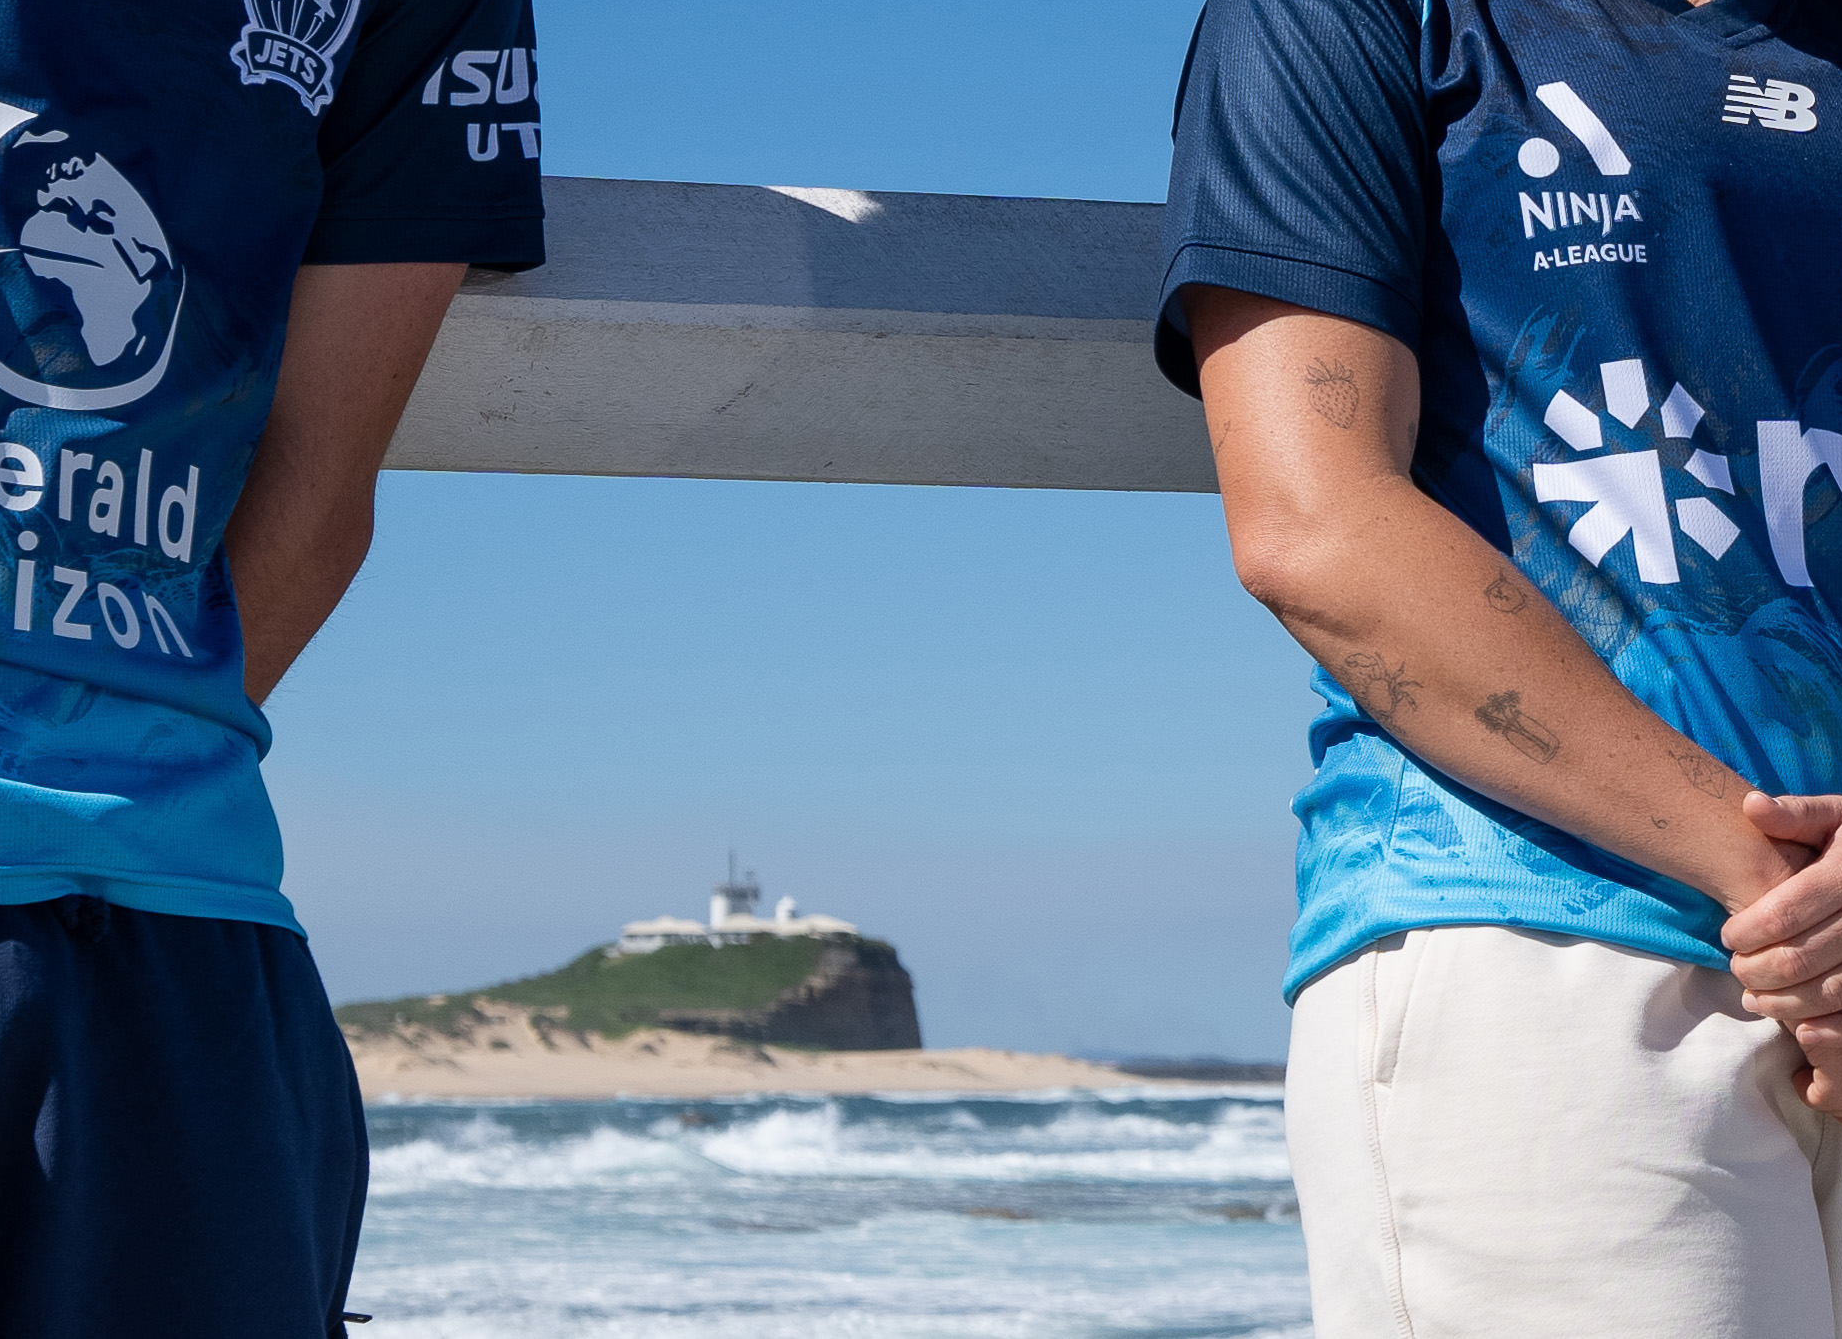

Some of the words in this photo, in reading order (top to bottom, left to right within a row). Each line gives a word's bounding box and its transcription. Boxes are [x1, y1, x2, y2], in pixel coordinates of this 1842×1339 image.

[254, 38, 317, 84] JETS
[422, 47, 540, 106] ISU
[467, 122, 542, 161] UT
[1518, 191, 1644, 239] NINJA
[1533, 243, 1648, 271] A-LEAGUE
